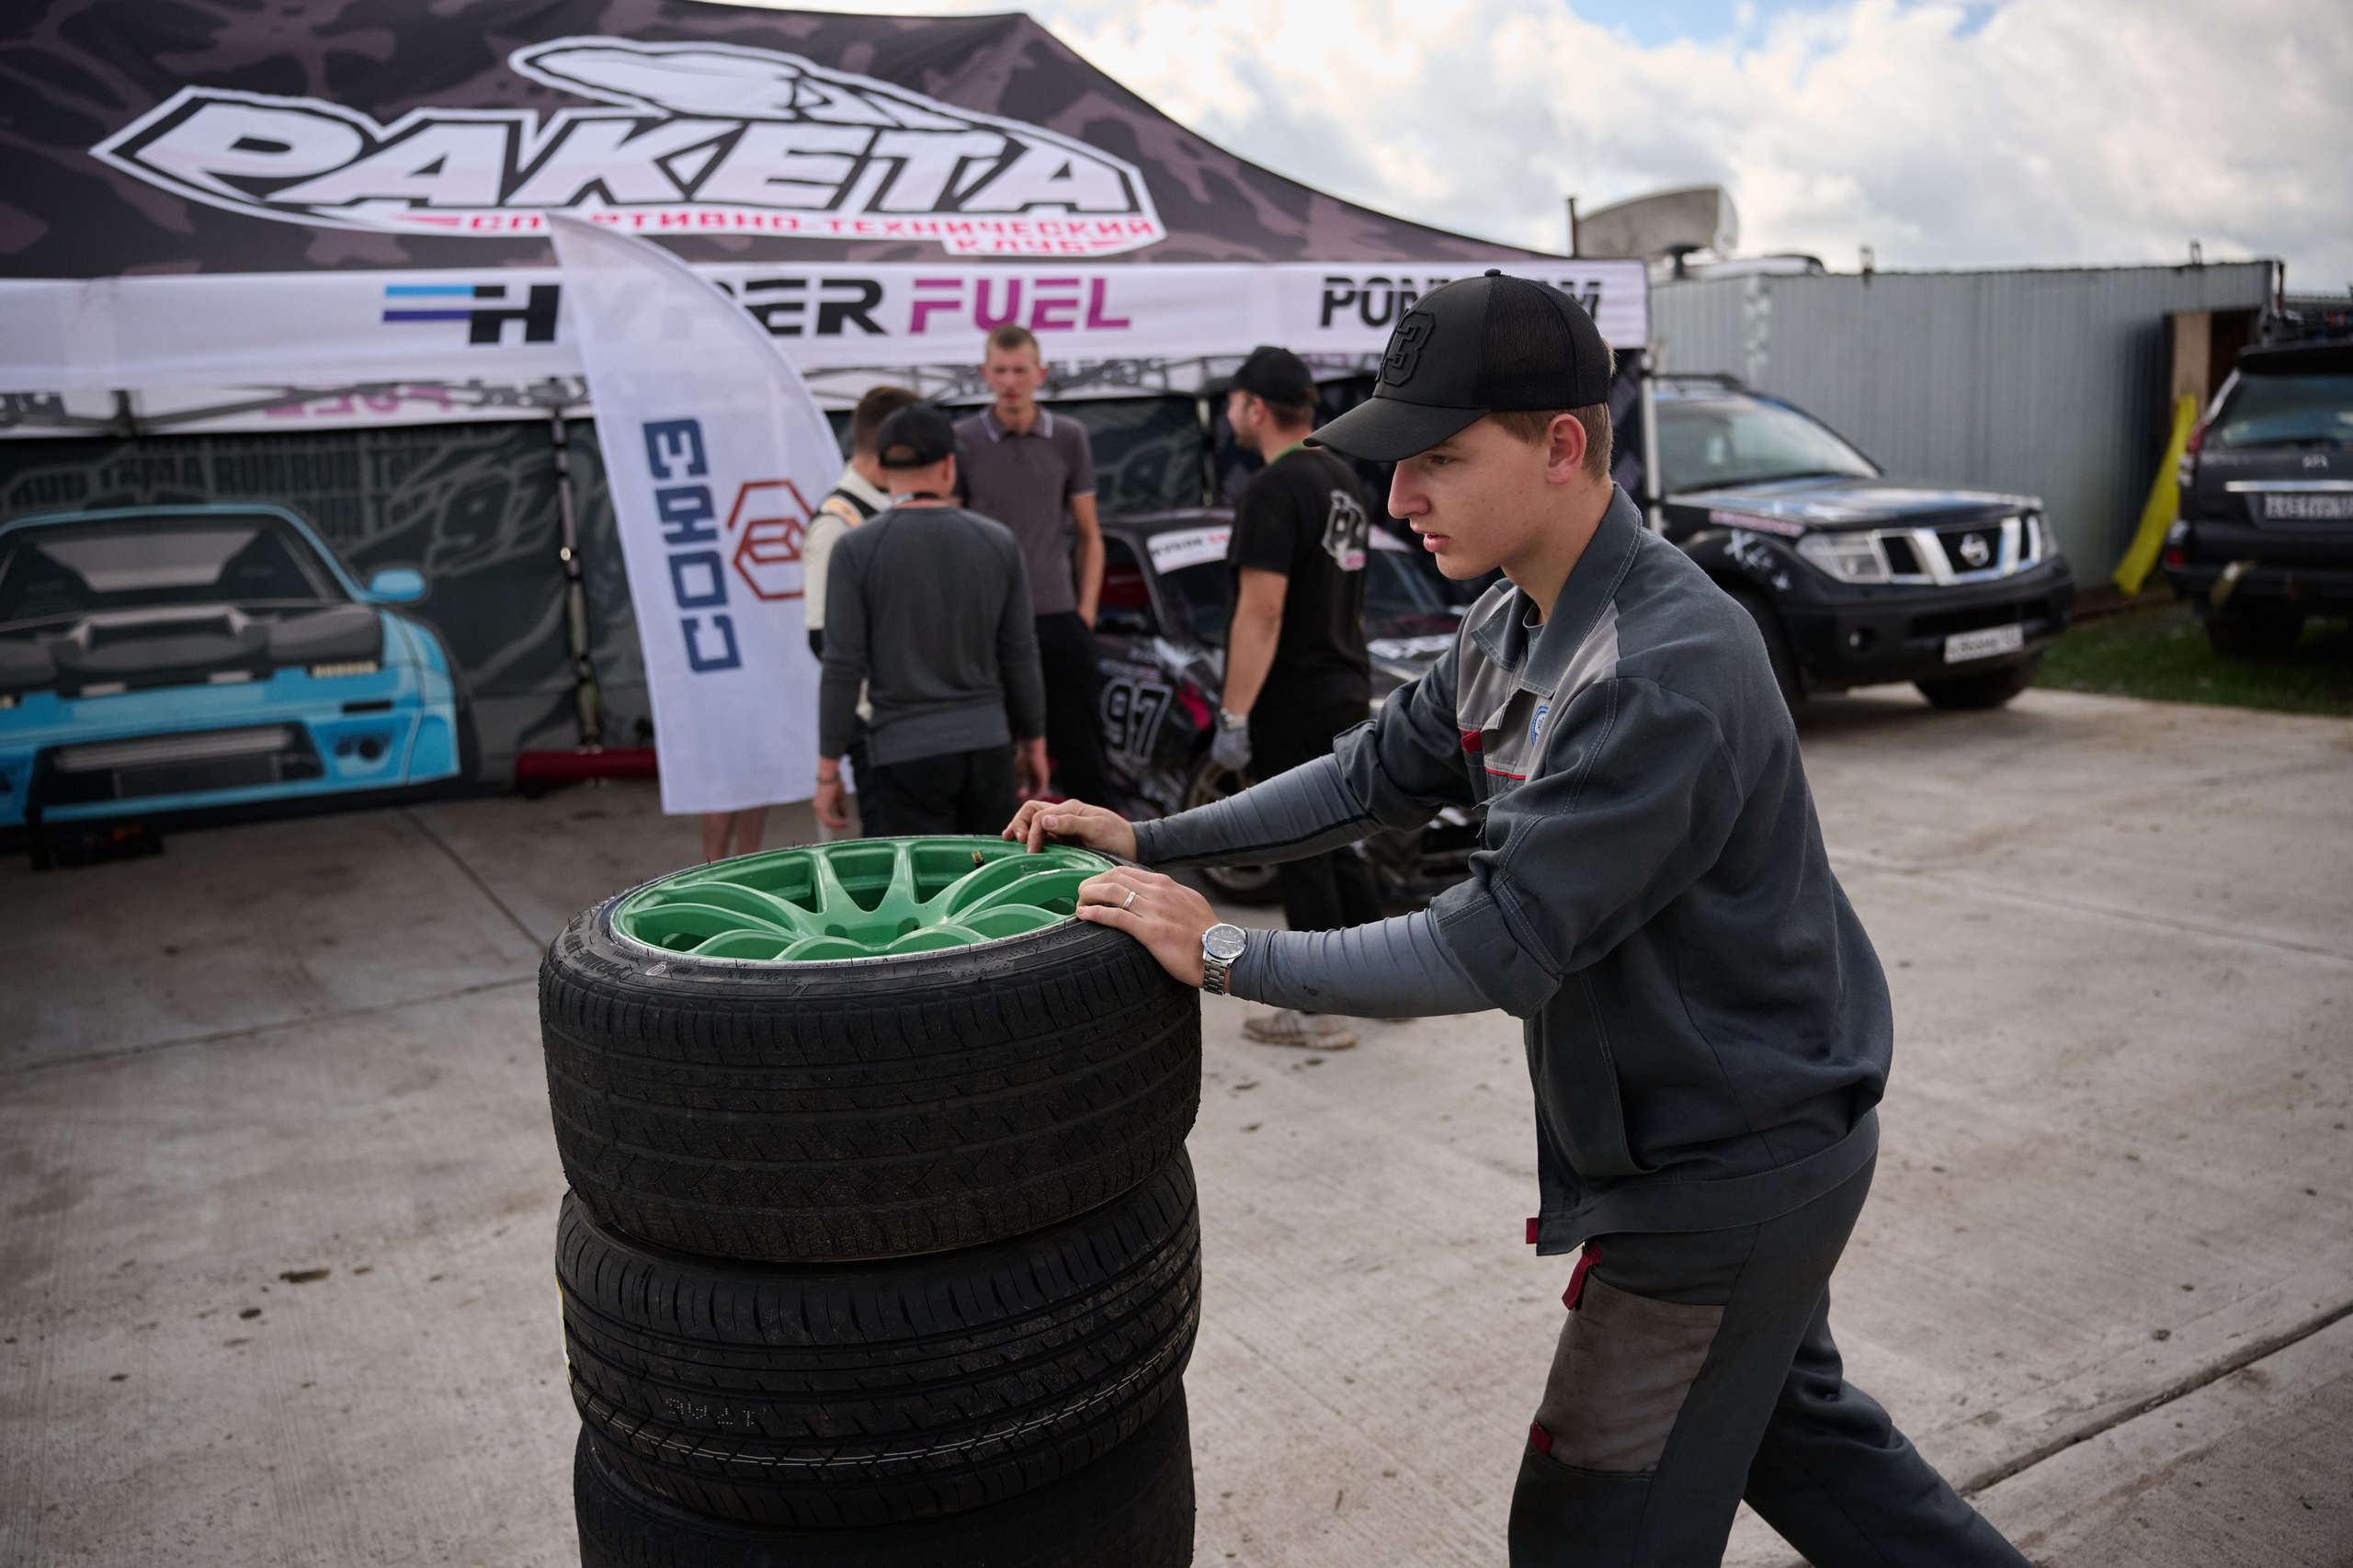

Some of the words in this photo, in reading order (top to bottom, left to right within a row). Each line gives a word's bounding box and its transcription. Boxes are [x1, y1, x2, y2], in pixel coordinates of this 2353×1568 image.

[131, 101, 1136, 213] РАКЕТА
[470, 211, 1155, 236] СПРТИВНО-ТЕХНИЧЕСКИЙ
[957, 239, 1086, 254] КЛУБ
[909, 278, 1131, 333] FUEL
[642, 419, 742, 676] СОЮЗ
[1100, 677, 1175, 767] 97
